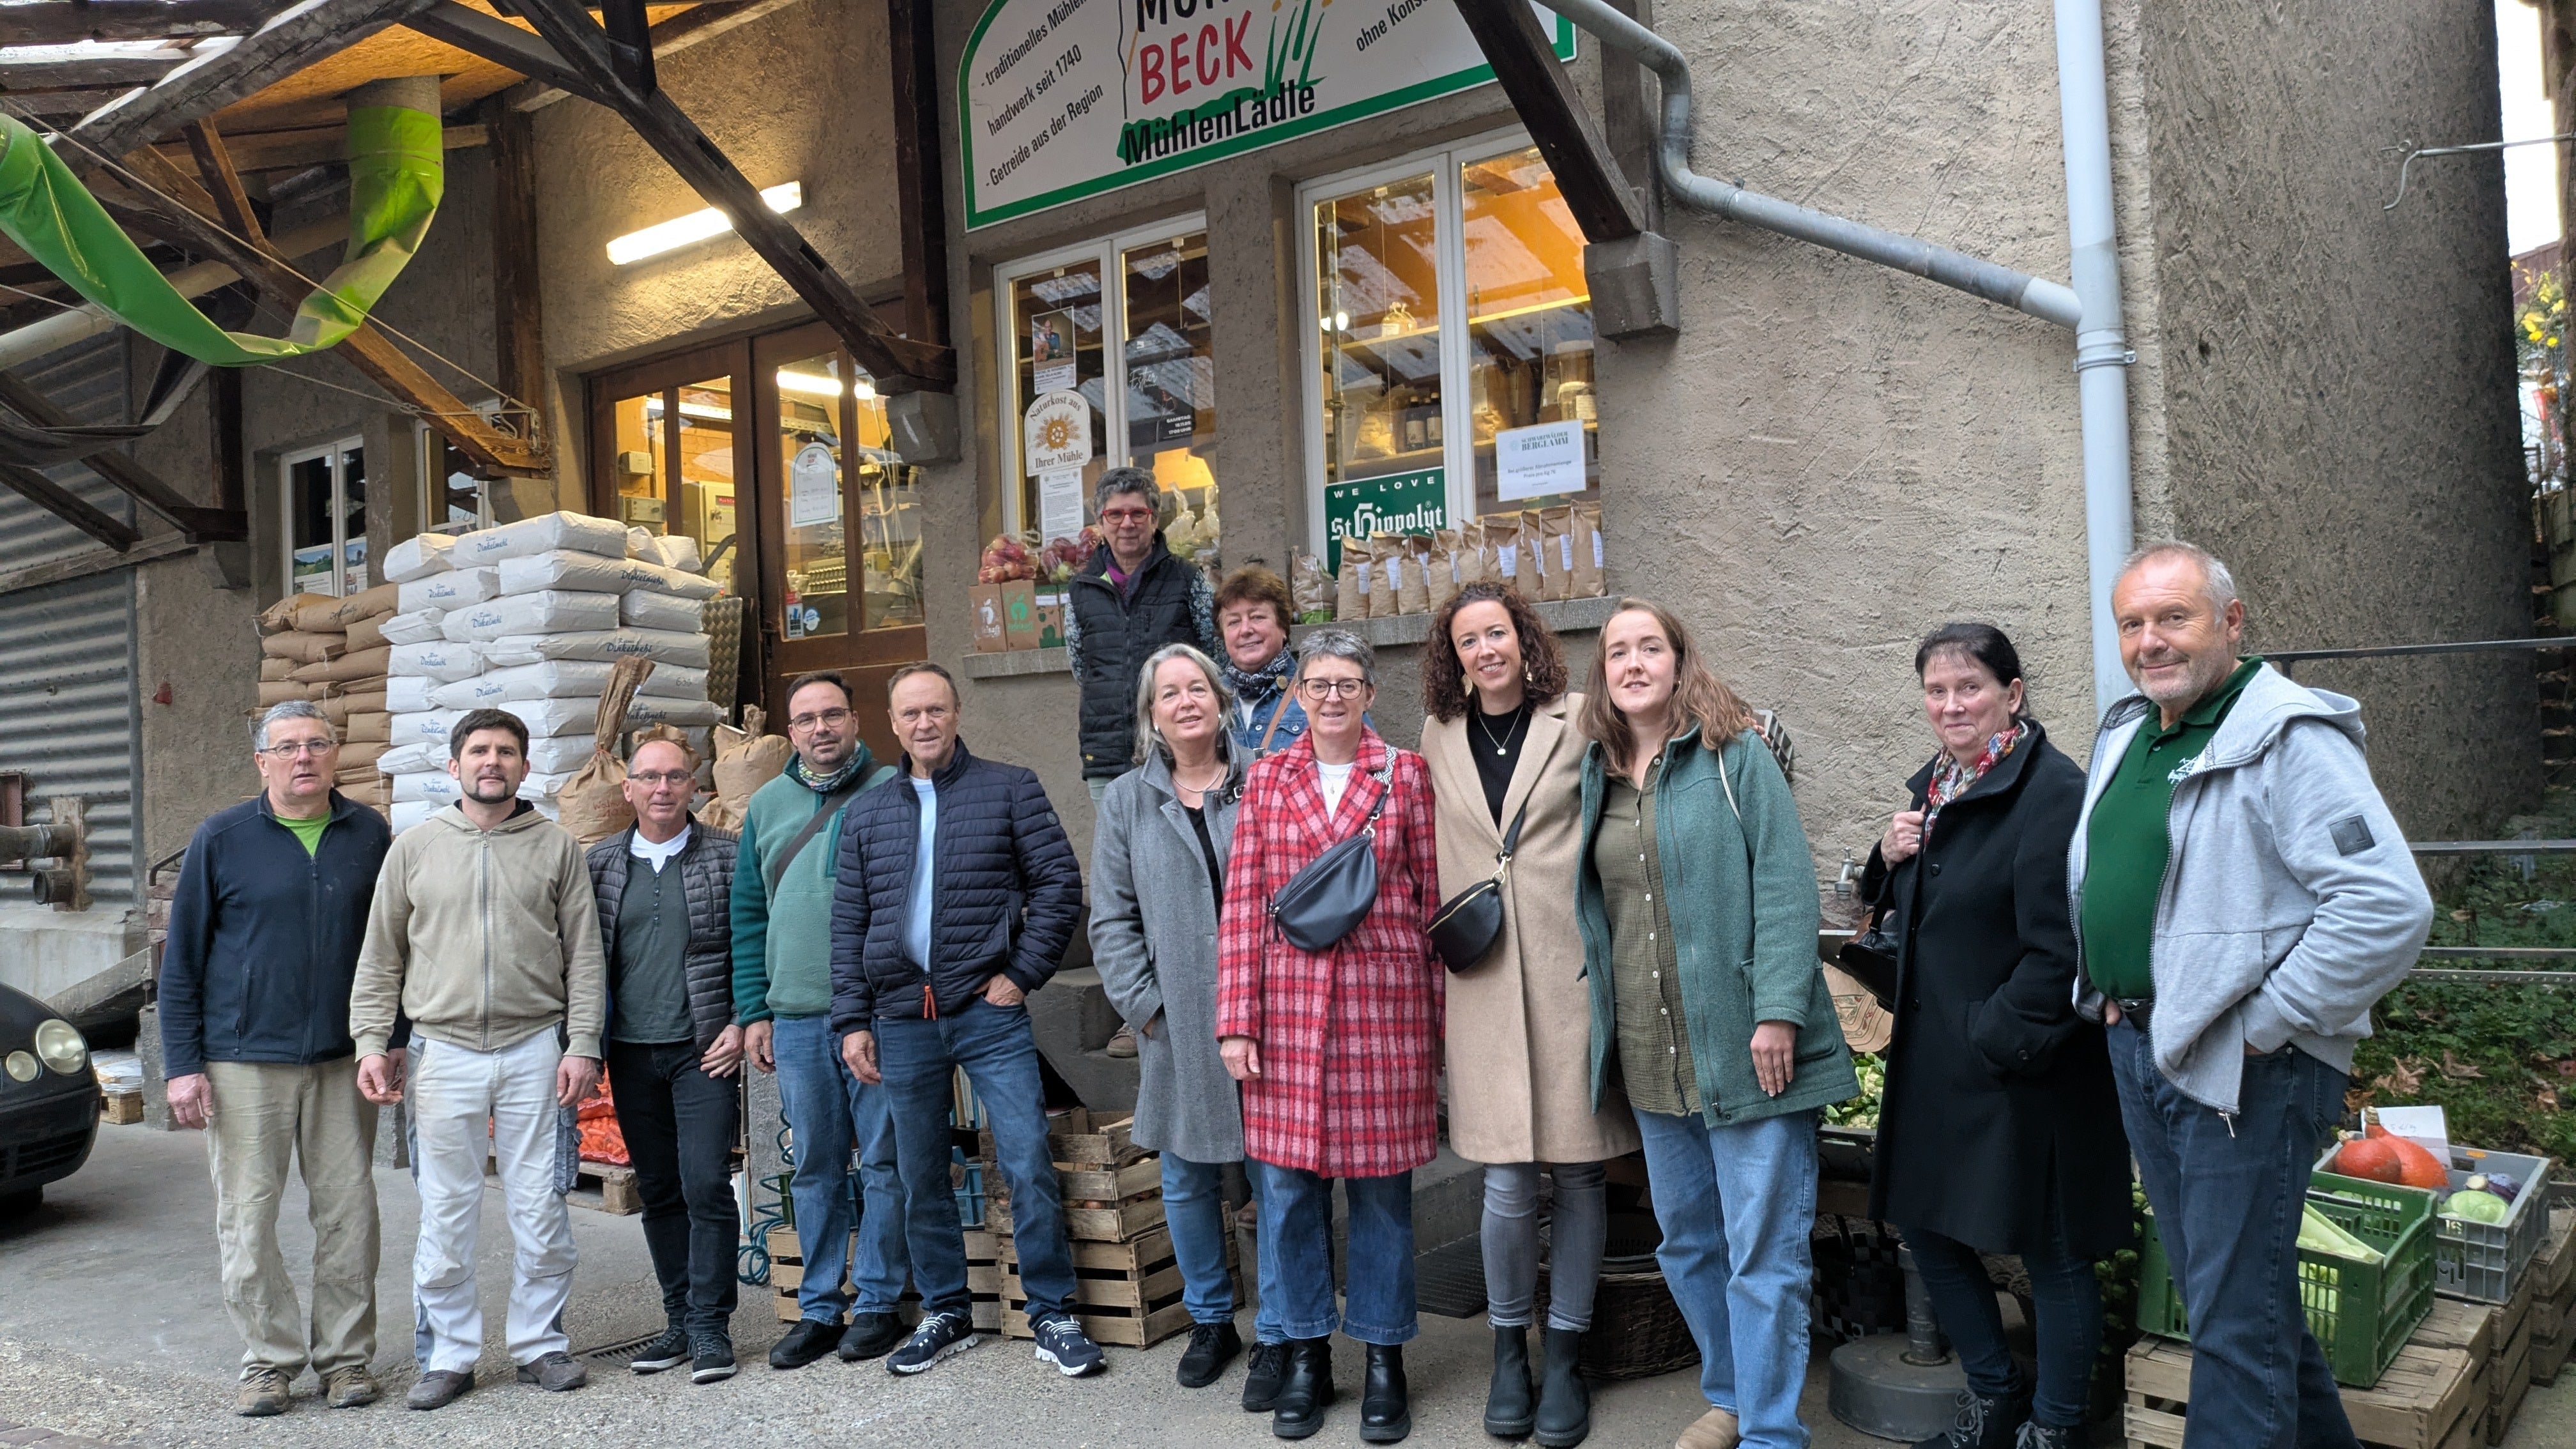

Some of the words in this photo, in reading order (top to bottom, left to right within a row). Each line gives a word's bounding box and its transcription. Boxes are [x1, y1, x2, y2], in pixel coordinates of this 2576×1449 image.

[1356, 20, 1388, 52] ohne
[985, 24, 1048, 86] traditionelles
[1140, 10, 1254, 105] BECK
[987, 86, 1036, 136] handwerk
[1036, 69, 1056, 95] seit
[1055, 43, 1082, 77] 1740
[990, 145, 1031, 186] Getreide
[1031, 130, 1050, 152] aus
[1050, 114, 1067, 135] der
[1066, 84, 1103, 121] Region
[1124, 79, 1315, 166] MühlenLädle
[1030, 395, 1066, 421] Naturkost
[1068, 399, 1082, 411] aus
[1035, 457, 1055, 468] Ihrer
[1057, 450, 1083, 464] Mühle
[1522, 437, 1568, 451] BERGLAMM
[1333, 487, 1359, 498] WE
[1380, 476, 1435, 492] LOVE
[606, 642, 653, 653] Dinkelmehl
